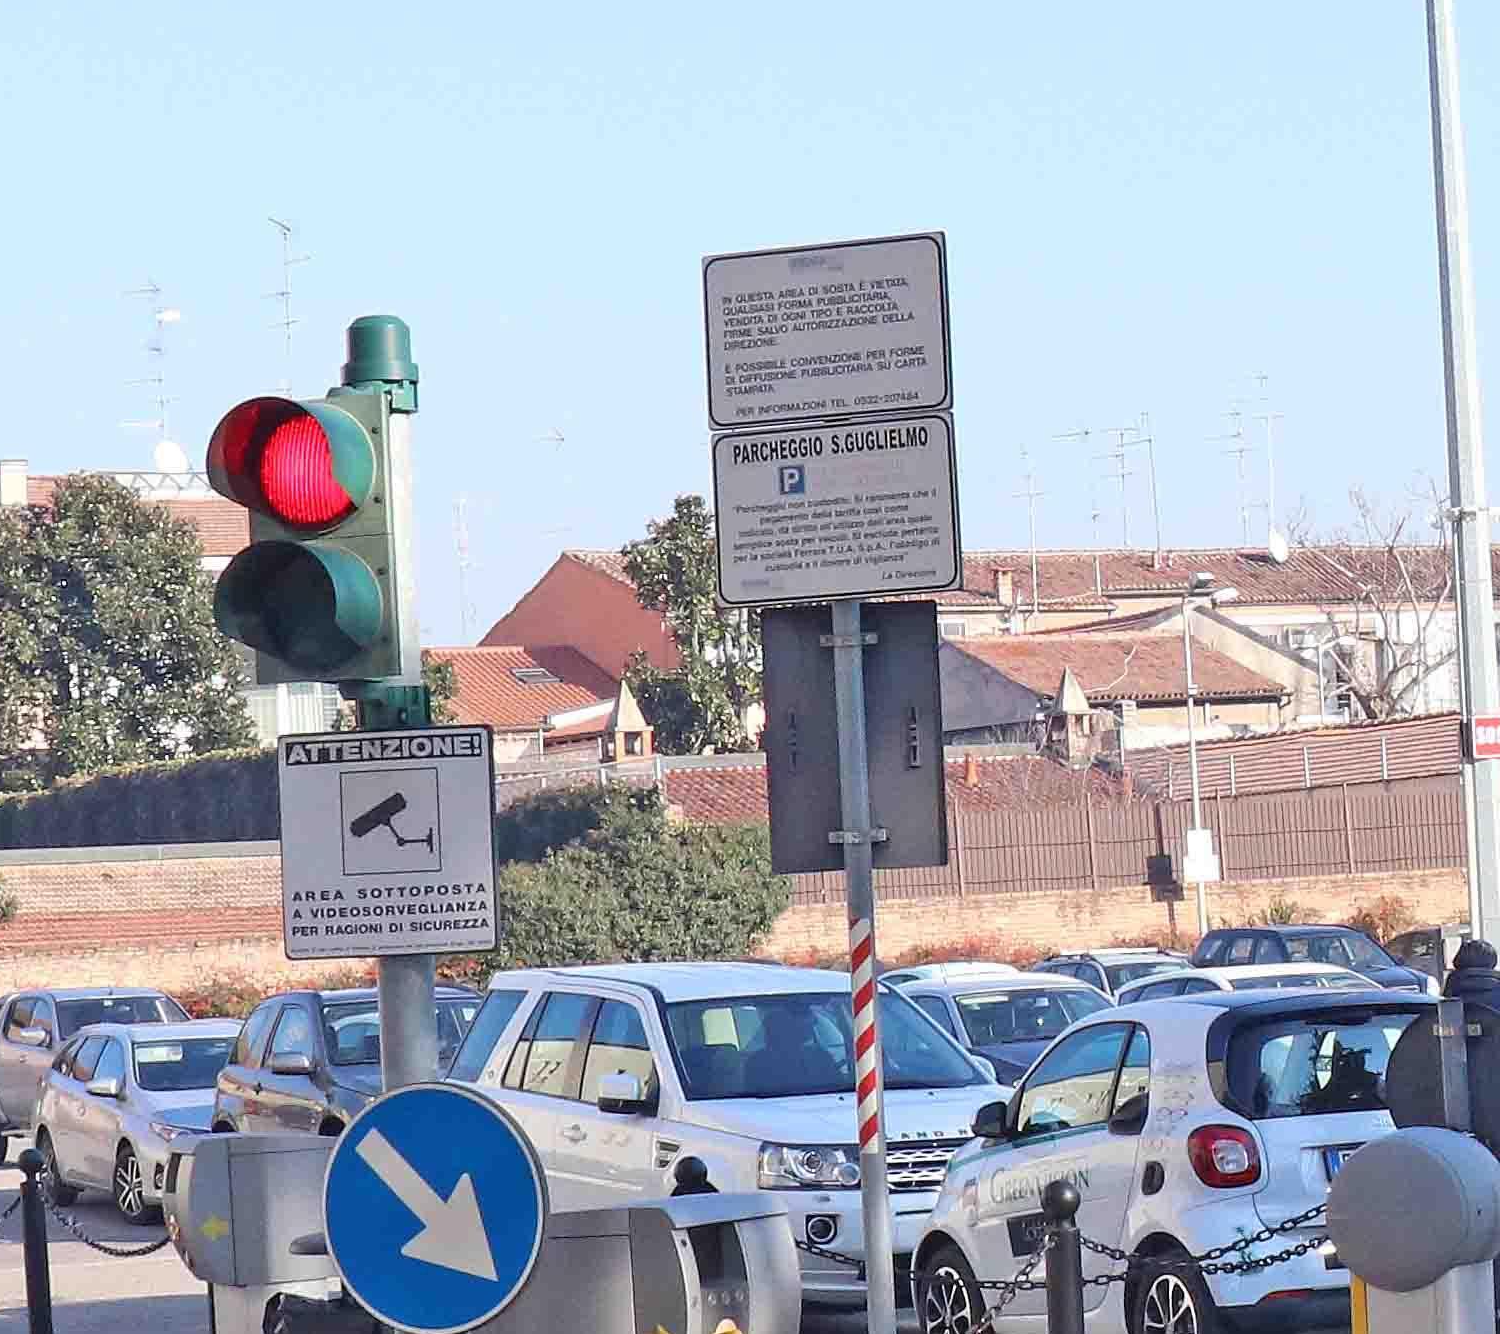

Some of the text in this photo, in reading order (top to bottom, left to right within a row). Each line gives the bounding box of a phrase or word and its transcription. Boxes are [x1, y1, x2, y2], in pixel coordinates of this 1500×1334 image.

[779, 288, 804, 299] AREA
[809, 287, 818, 295] DI
[823, 283, 855, 294] SOSTA
[724, 315, 764, 327] VENDITA
[768, 315, 777, 323] DI
[782, 311, 805, 321] OGNI
[810, 308, 831, 318] TIPO
[847, 302, 899, 315] RACCOLTA
[779, 299, 813, 309] FORMA
[757, 324, 788, 335] SALVO
[792, 315, 877, 331] AUTORIZZAZIONE
[882, 311, 915, 323] DELLA
[725, 376, 735, 385] DI
[740, 371, 796, 384] DIFFUSIONE
[876, 361, 891, 371] SU
[895, 357, 927, 369] CARTA
[736, 361, 787, 373] POSSIBILE
[791, 351, 861, 367] CONVENZIONE
[867, 350, 885, 360] PER
[890, 346, 924, 357] FORME
[733, 426, 928, 465] PARCHEGGIO S.GUGLIELMO
[784, 468, 799, 493] P
[287, 735, 481, 764] ATTENZIONE!
[292, 883, 486, 902] AREA SOTTOPOSTA
[293, 901, 487, 919] A VIDEOSORVEGLIANZA
[292, 918, 490, 937] PER RAGIONI DI SICUREZZA
